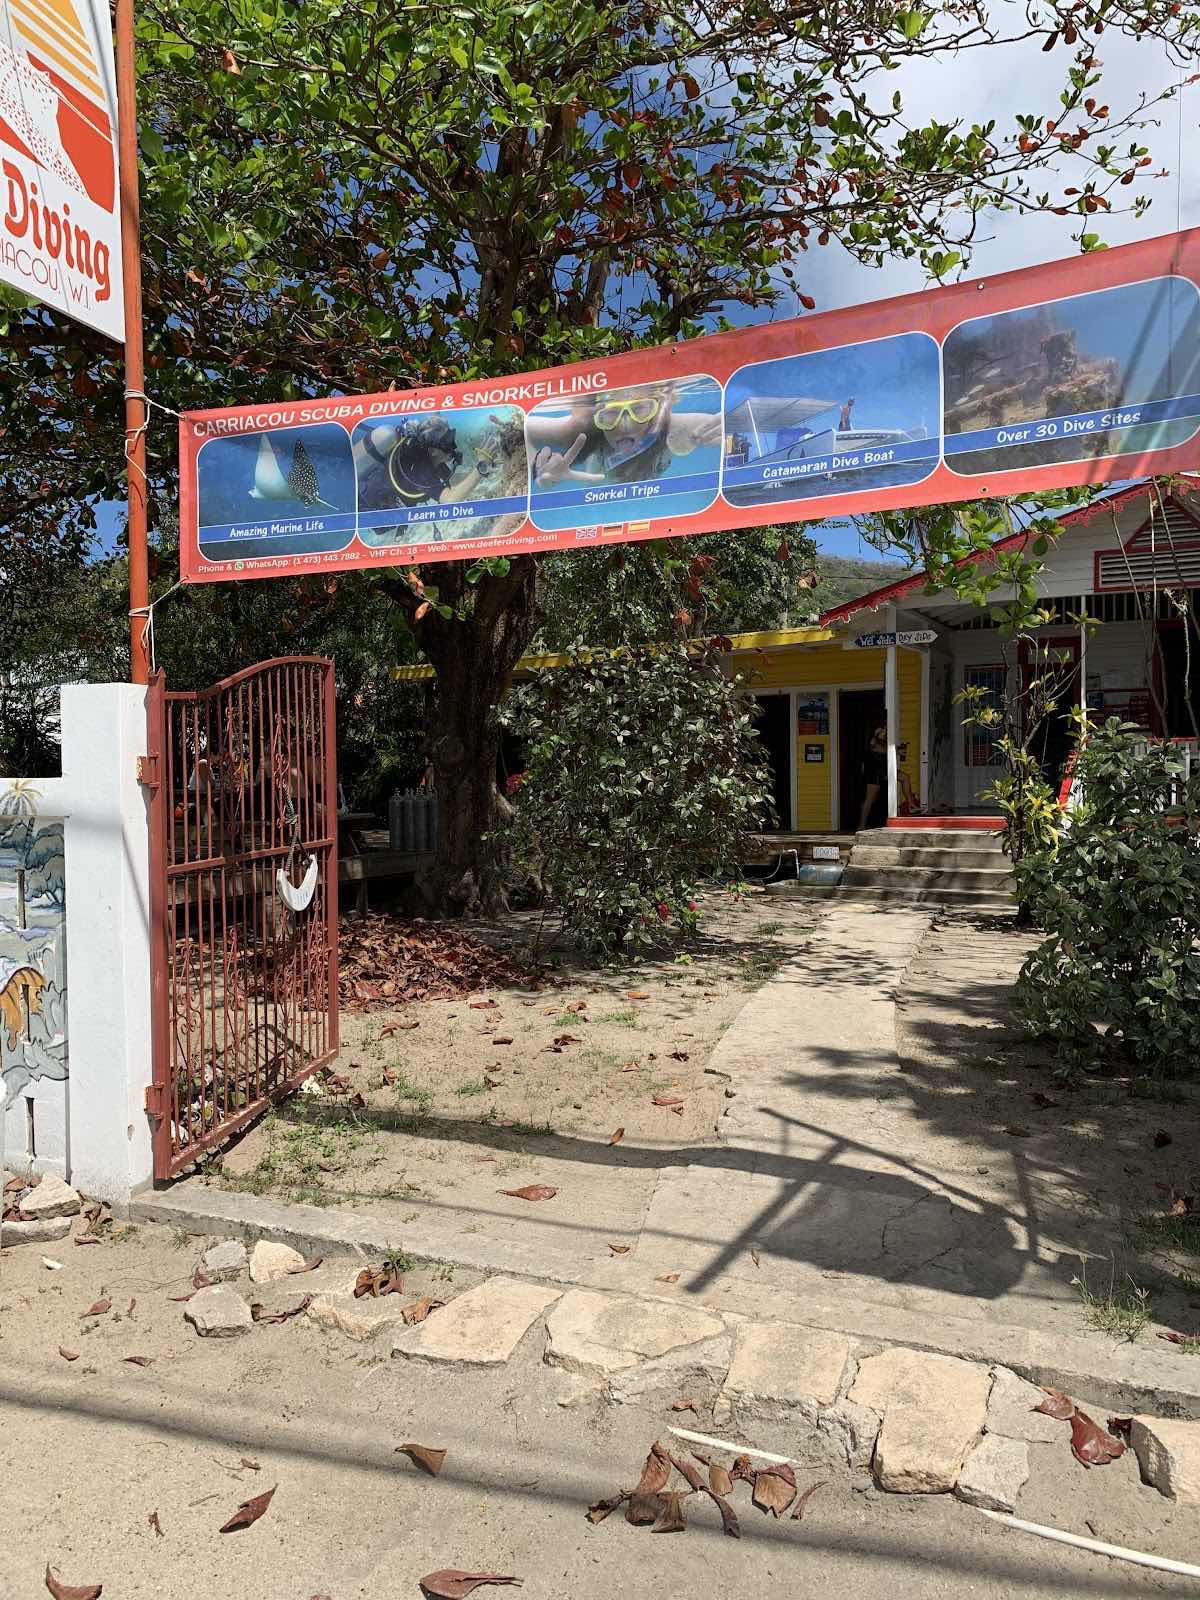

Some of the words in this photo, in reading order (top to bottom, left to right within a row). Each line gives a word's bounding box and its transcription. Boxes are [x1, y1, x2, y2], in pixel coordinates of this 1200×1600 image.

[2, 157, 110, 302] Diving
[193, 411, 295, 437] CARRIACOU
[299, 401, 364, 422] SCUBA
[369, 398, 435, 415] DIVING
[441, 395, 455, 408] &
[462, 371, 608, 406] SNORKELLING
[996, 430, 1031, 444] Over
[1035, 423, 1058, 438] 30
[1063, 420, 1096, 433] Dive
[1101, 411, 1142, 428] Sites
[762, 460, 828, 478] Catamaran
[832, 456, 860, 469] Dive
[864, 449, 895, 464] Boat
[584, 484, 627, 503] Snorkel
[631, 483, 660, 498] Trips
[229, 526, 268, 538] Amazing
[271, 522, 303, 535] Marine
[306, 520, 325, 531] Life
[408, 511, 436, 521] Learn
[439, 508, 449, 518] to
[452, 506, 474, 517] Dive
[198, 564, 224, 573] Phone
[369, 549, 387, 558] VHF
[452, 534, 558, 550] www.deeferdiving.com
